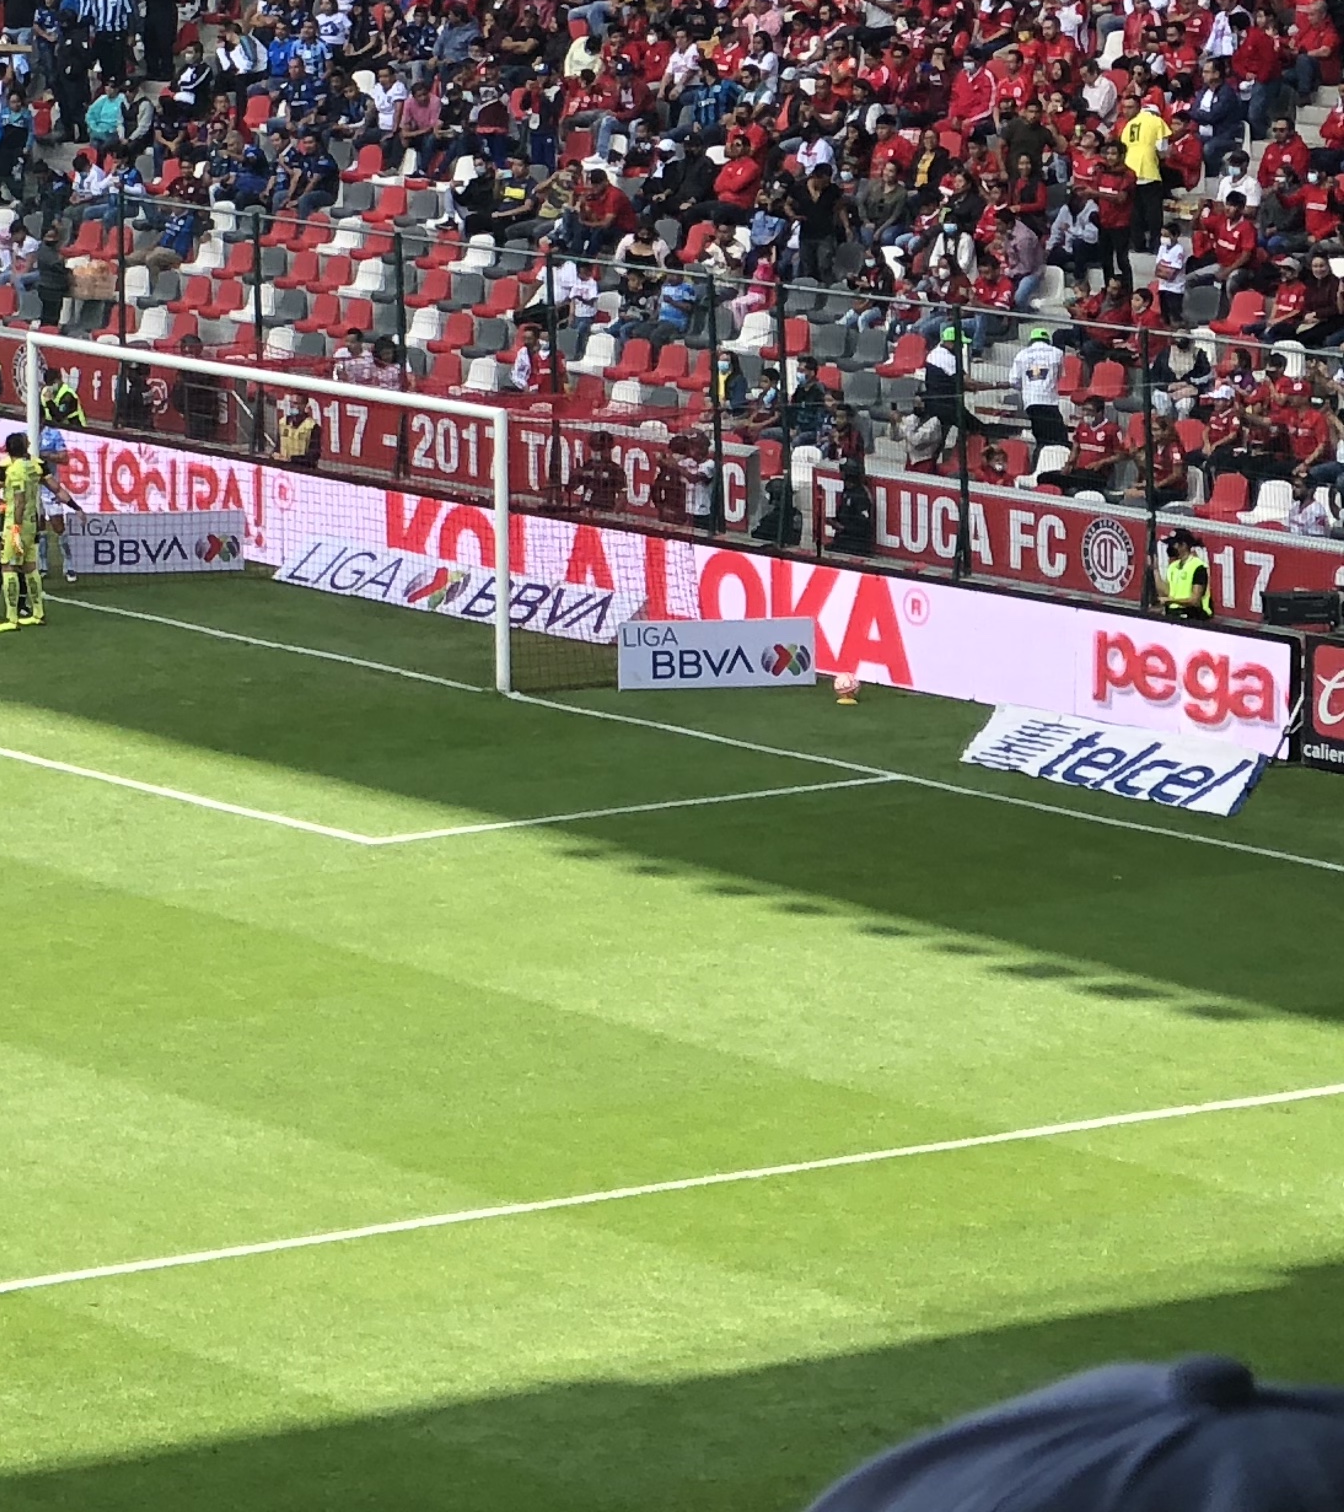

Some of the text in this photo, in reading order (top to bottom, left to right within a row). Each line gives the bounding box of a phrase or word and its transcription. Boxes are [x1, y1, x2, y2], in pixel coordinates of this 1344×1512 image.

[68, 517, 120, 538] LIGA
[93, 535, 189, 567] BBVA
[817, 475, 994, 566] TLUCA
[1009, 508, 1068, 578] FC
[287, 541, 616, 634] LIGA BBVA
[622, 626, 679, 649] LIGA
[651, 645, 755, 681] BBVA
[1091, 629, 1275, 725] pega
[1037, 730, 1255, 807] telcel
